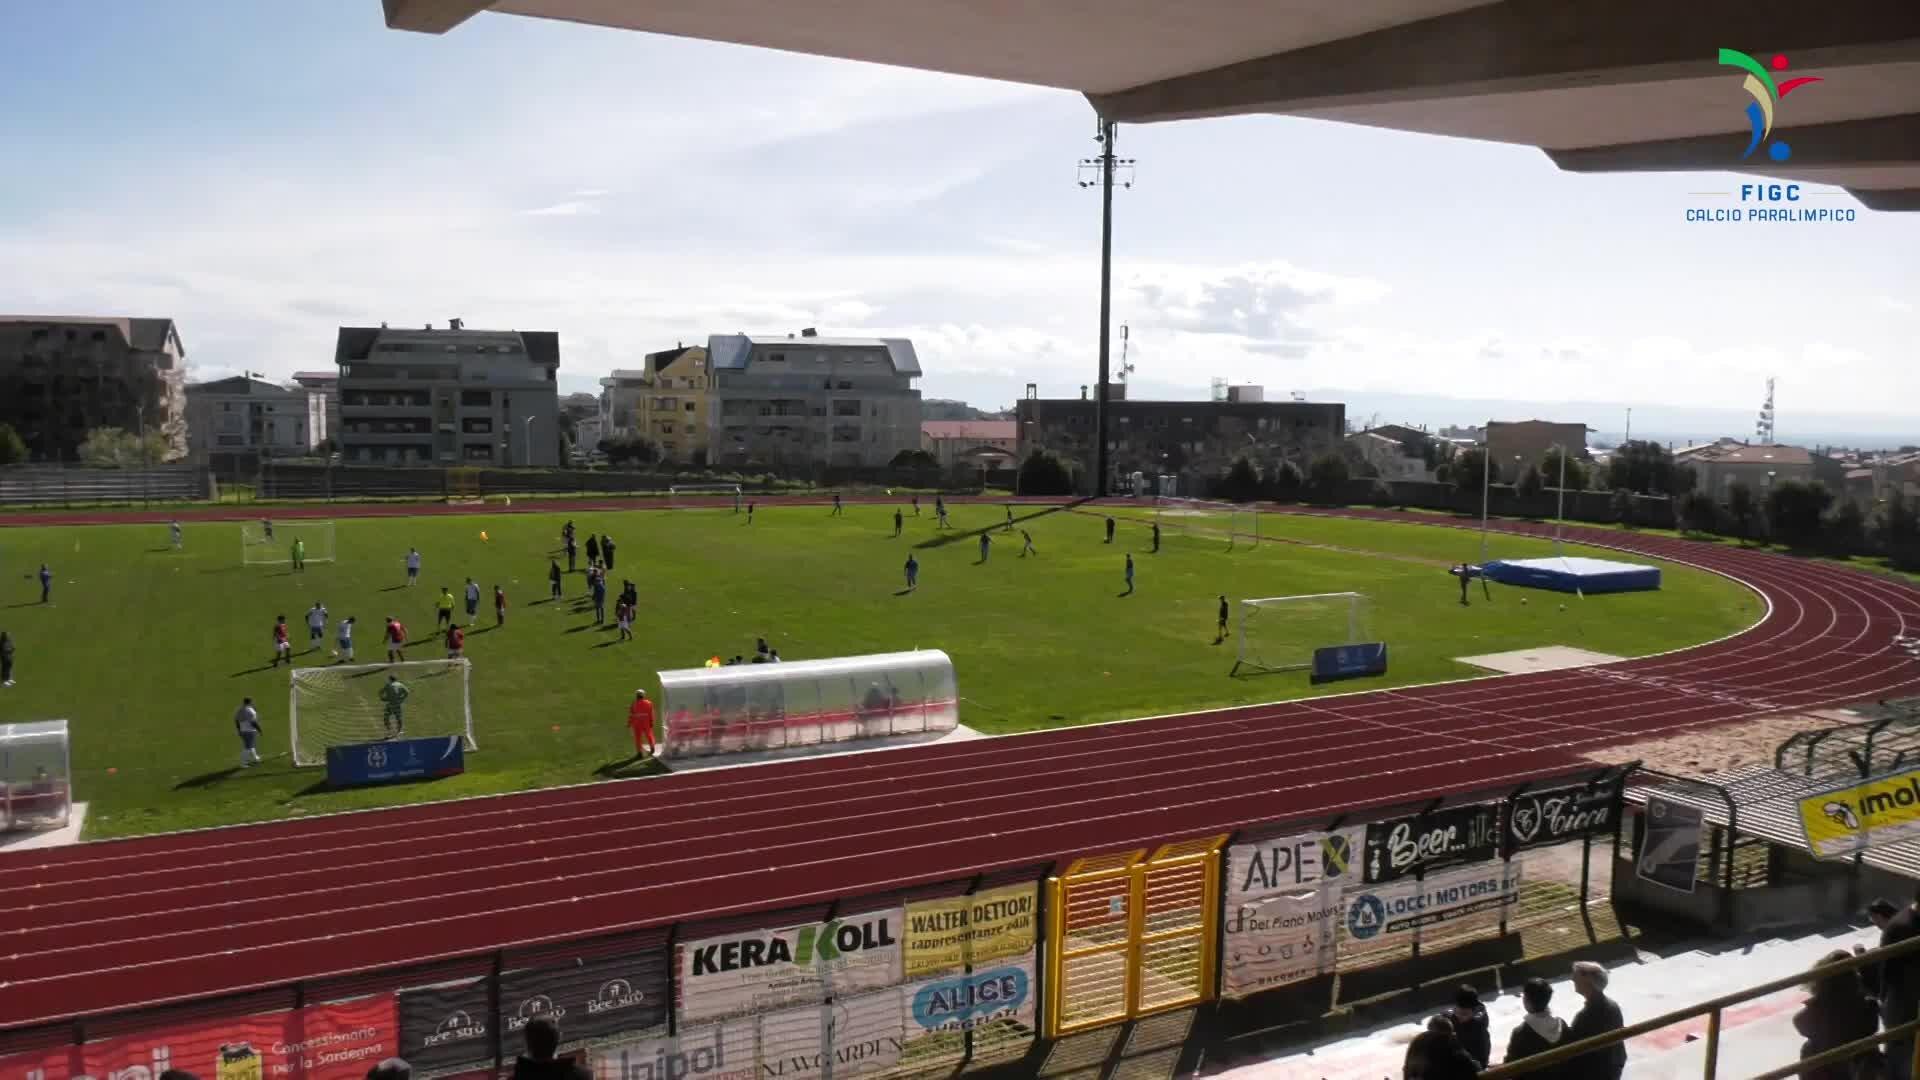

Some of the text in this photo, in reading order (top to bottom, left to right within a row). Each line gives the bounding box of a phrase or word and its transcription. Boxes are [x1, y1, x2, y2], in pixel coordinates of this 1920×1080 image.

[1240, 834, 1352, 892] APEX
[911, 895, 1032, 934] WALTER DETTORI
[1385, 894, 1432, 916] LOCCI
[1436, 879, 1498, 905] MOTORS
[692, 917, 897, 977] KERAKOLL
[924, 974, 1018, 1017] ALICE
[271, 1024, 377, 1057] Concessionario
[316, 1043, 383, 1066] Sardegna
